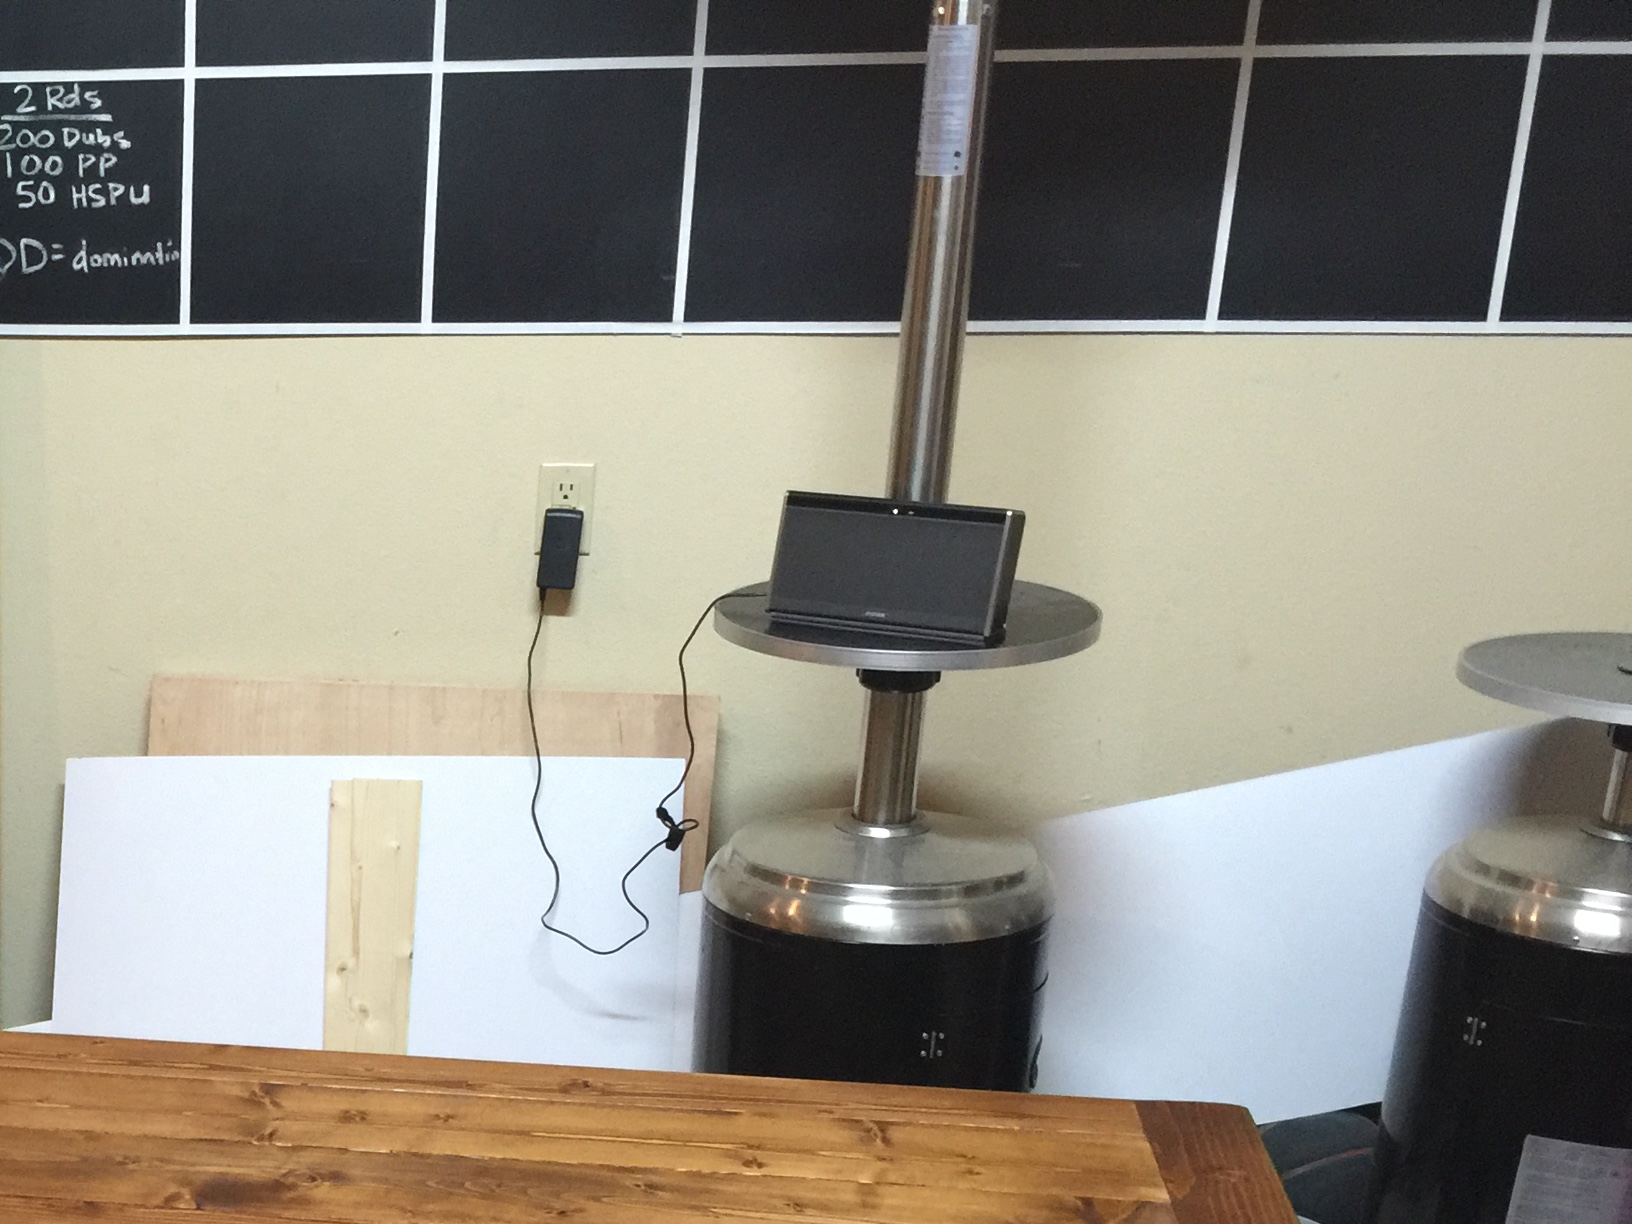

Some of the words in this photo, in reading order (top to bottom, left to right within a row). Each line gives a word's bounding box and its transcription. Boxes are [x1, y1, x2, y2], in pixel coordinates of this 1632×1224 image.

[14, 84, 37, 113] 2
[46, 83, 103, 112] Rds
[62, 127, 132, 150] Dubs
[5, 152, 64, 178] 100
[77, 152, 118, 178] PP
[16, 180, 56, 209] 50
